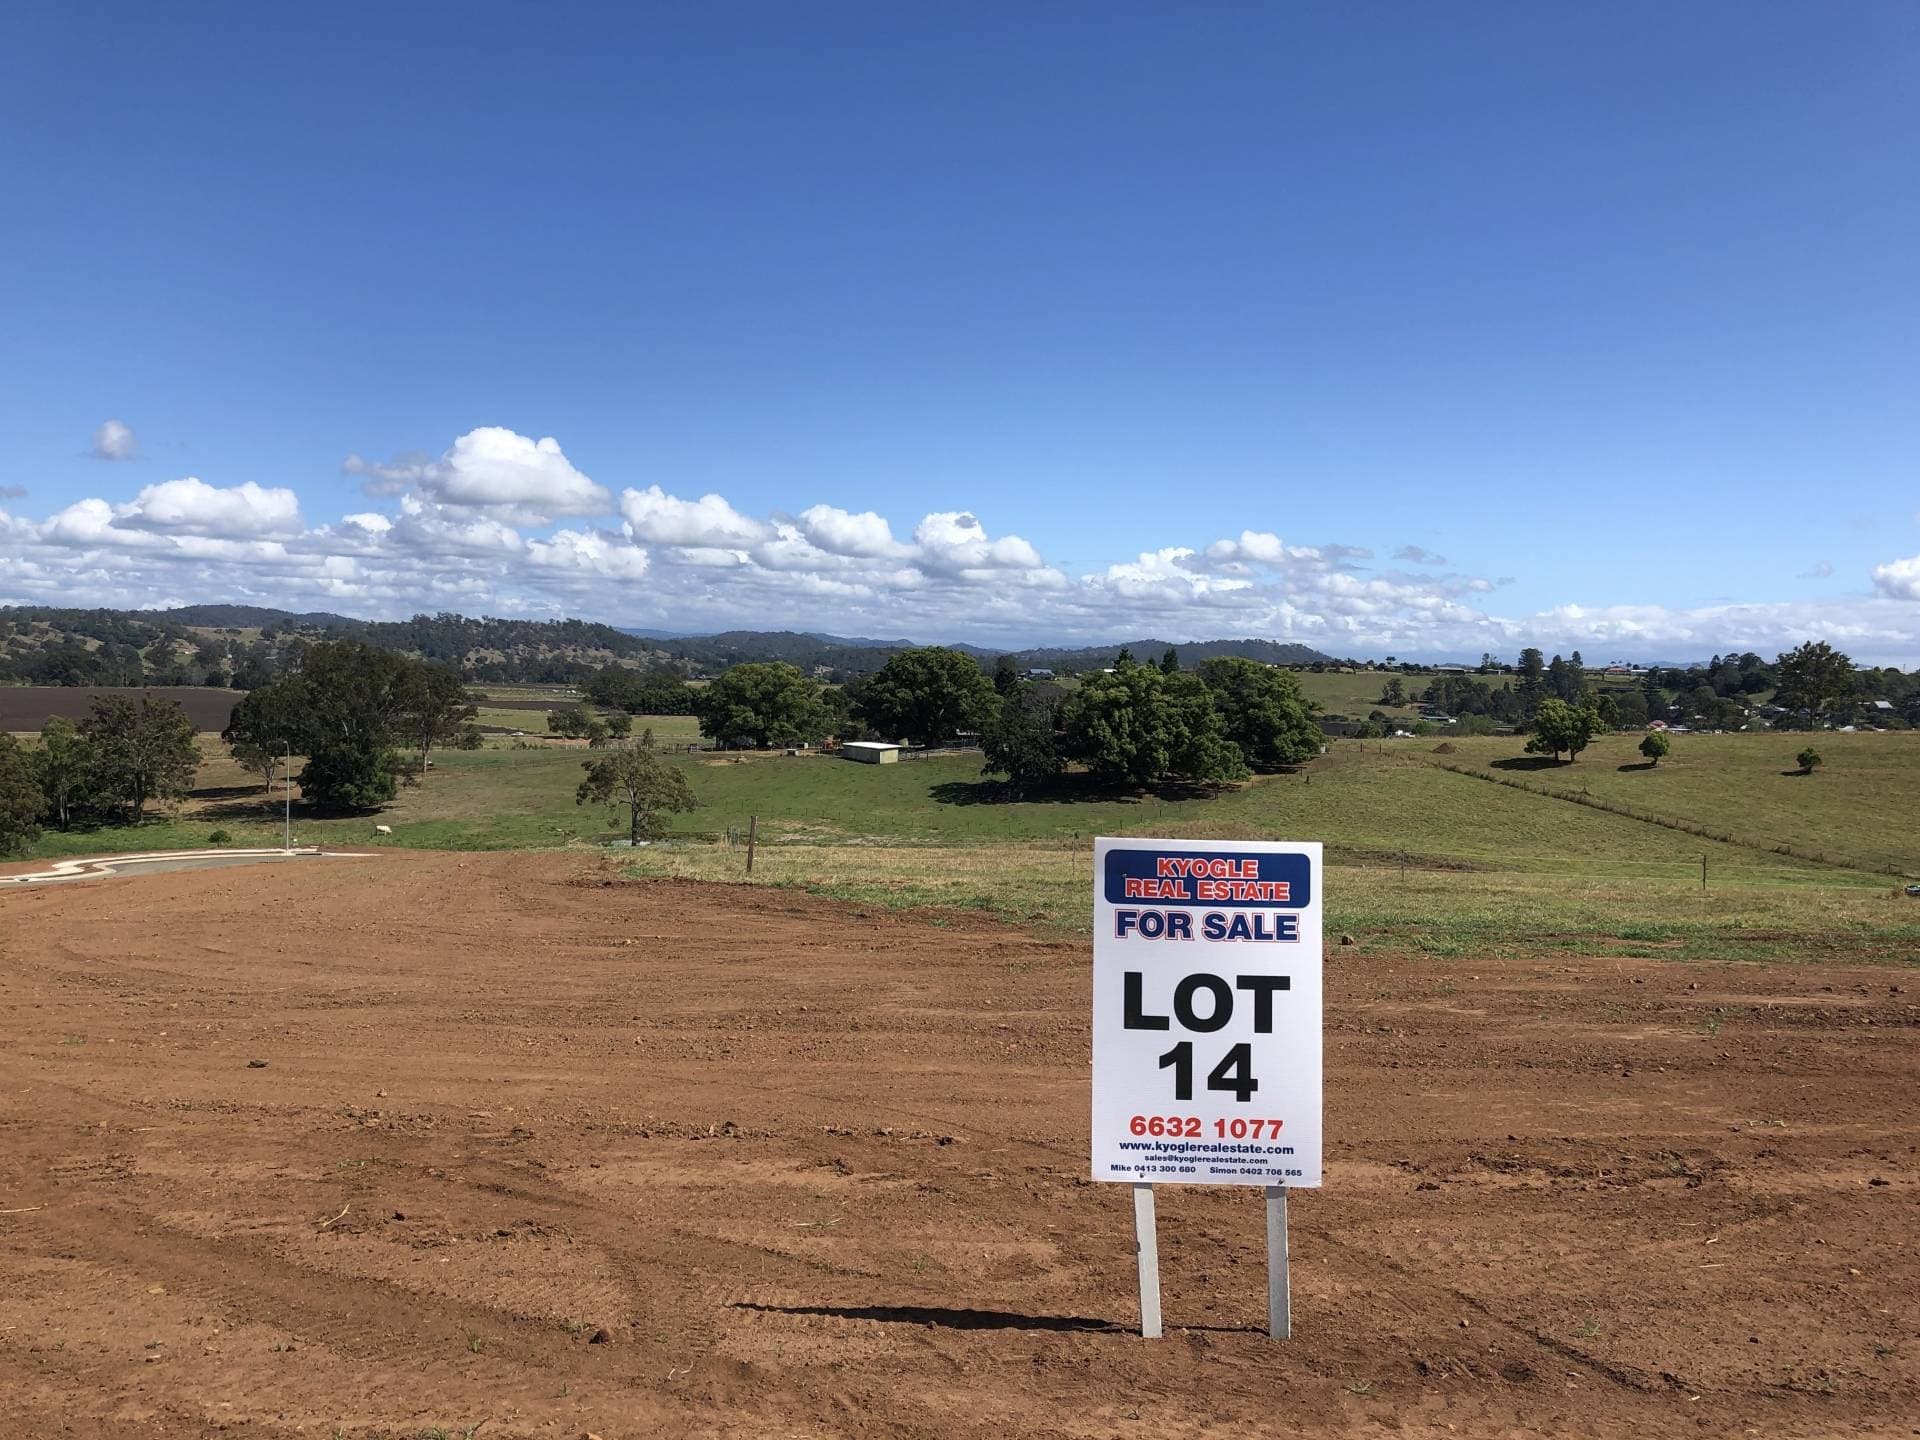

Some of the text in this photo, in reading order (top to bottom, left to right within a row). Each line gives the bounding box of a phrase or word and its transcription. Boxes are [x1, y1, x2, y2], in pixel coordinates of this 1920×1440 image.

[1157, 858, 1258, 879] KYOGLE
[1125, 878, 1290, 901] REAL ESTATE
[1115, 909, 1300, 943] FOR SALE
[1124, 971, 1291, 1033] LOT
[1159, 1041, 1258, 1102] 14
[1130, 1116, 1284, 1140] 6632 1077
[1119, 1141, 1294, 1155] www.kyoglerealestate.com
[1110, 1164, 1132, 1172] Mike
[1134, 1165, 1157, 1173] 0413
[1159, 1165, 1176, 1173] 300
[1144, 1154, 1268, 1165] sales@kyoglerealestate.com
[1209, 1166, 1237, 1175] Simon
[1240, 1167, 1263, 1176] 0402
